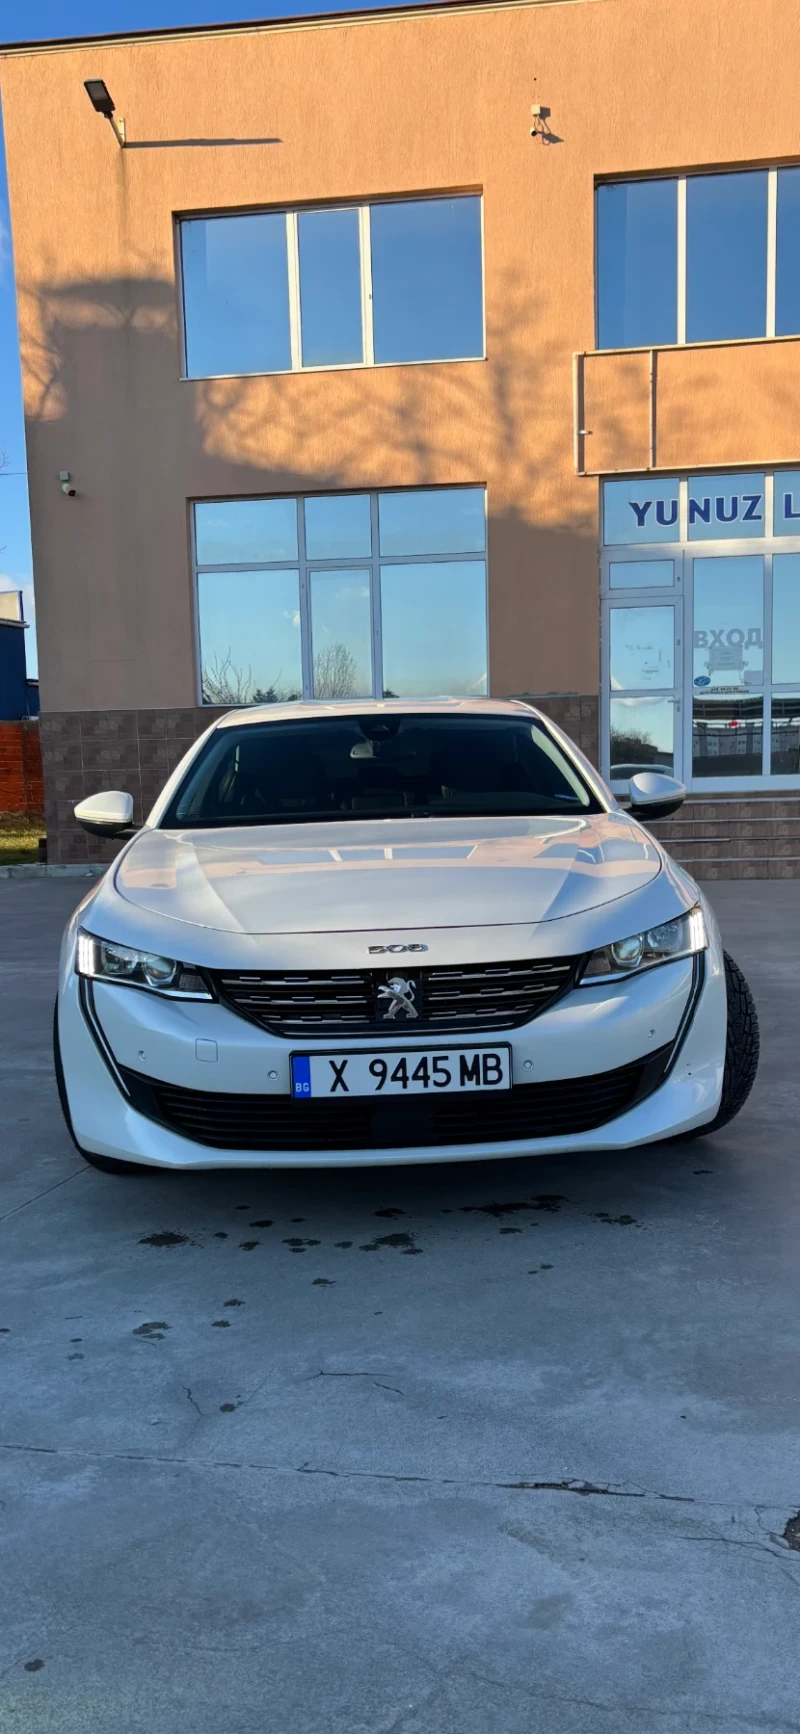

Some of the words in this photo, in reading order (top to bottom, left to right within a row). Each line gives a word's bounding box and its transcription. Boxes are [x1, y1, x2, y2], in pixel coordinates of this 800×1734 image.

[694, 628, 763, 650] ВХОД
[367, 943, 429, 954] 508
[368, 1055, 452, 1091] 9445
[459, 1053, 503, 1087] MB
[295, 1082, 310, 1093] BG
